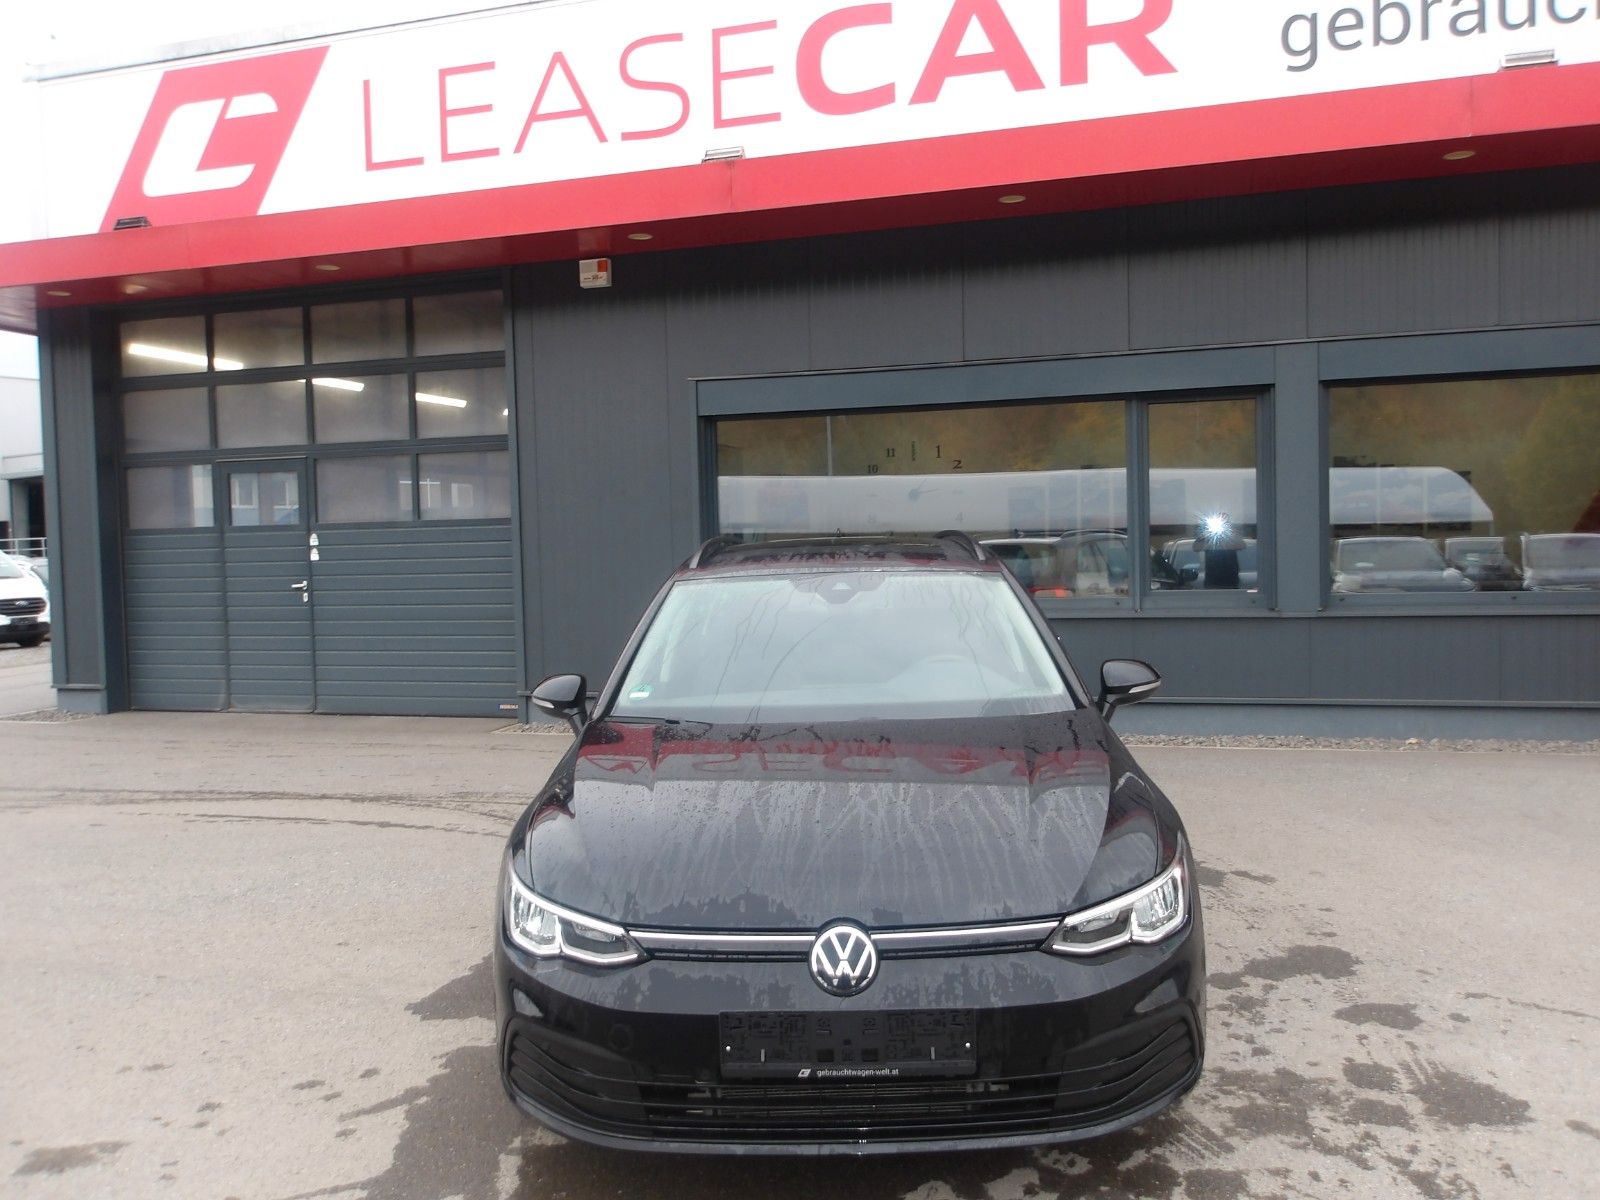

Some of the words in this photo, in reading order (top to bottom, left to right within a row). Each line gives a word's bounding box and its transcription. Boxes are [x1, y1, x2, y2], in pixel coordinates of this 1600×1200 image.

[1281, 0, 1600, 72] gebrauc
[866, 464, 879, 475] 10
[817, 1068, 899, 1077] gebrauchtwagen-welt.at
